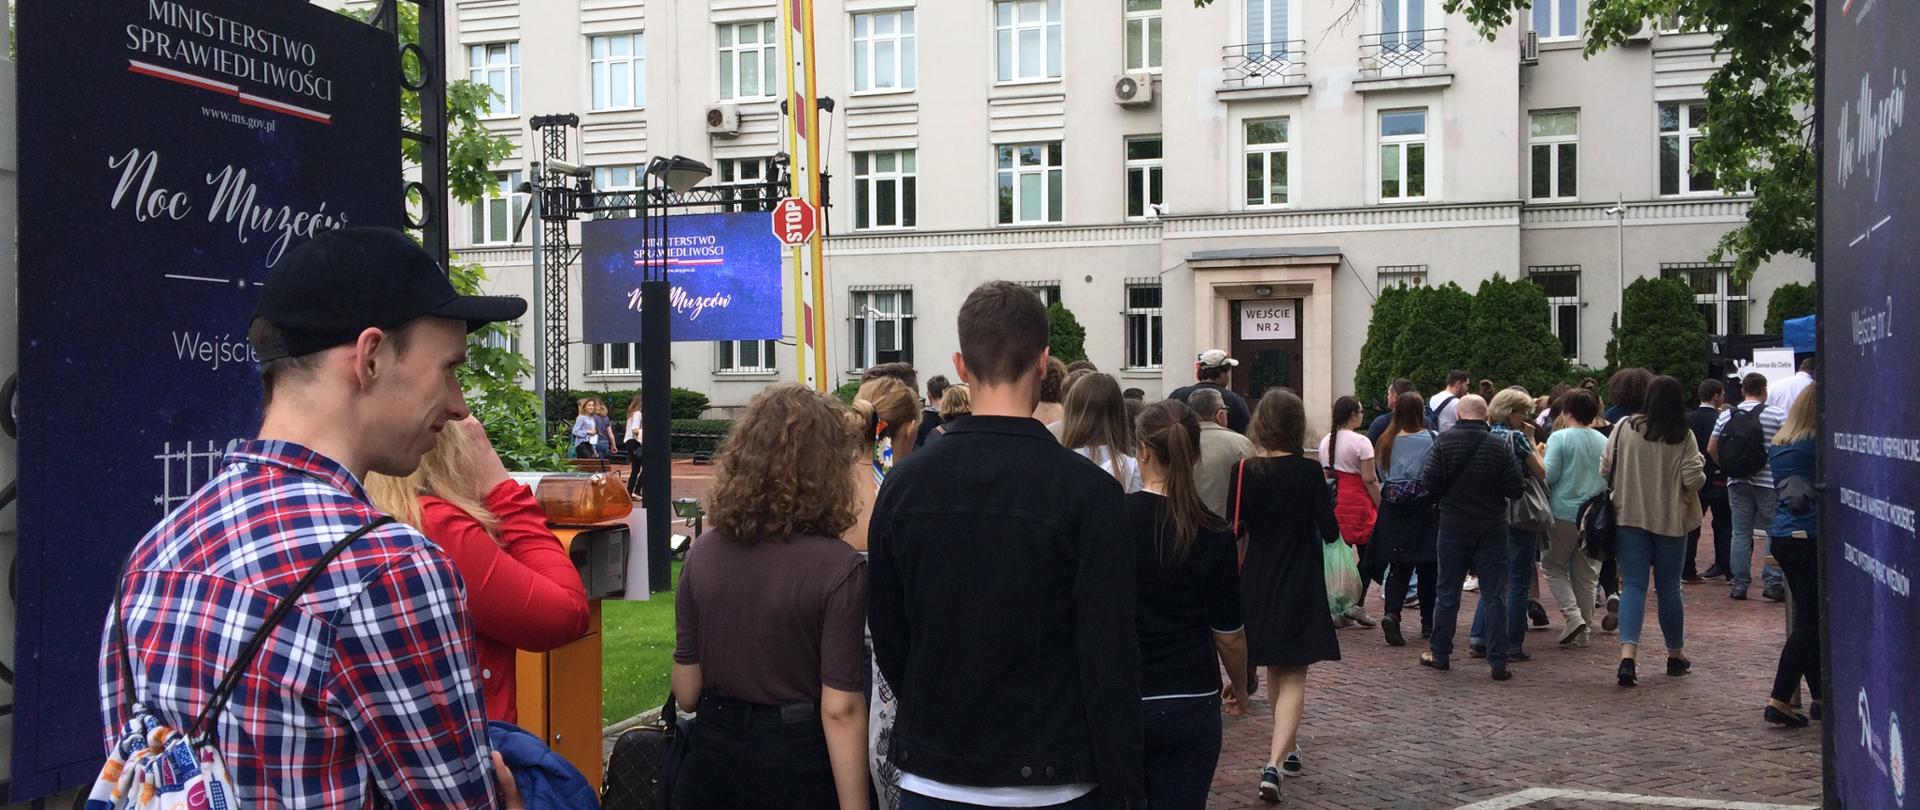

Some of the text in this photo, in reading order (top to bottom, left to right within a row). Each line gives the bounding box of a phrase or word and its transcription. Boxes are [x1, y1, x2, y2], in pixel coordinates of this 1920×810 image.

[149, 0, 316, 67] MINISTERSTWO
[126, 24, 332, 101] SPRAWIEDLIWOŚCI
[201, 105, 276, 133] www.ms.gov.pl
[109, 147, 192, 223] Noc
[785, 199, 802, 244] STOP
[1246, 308, 1290, 318] WEJŚCIE
[1257, 323, 1280, 331] NR 2
